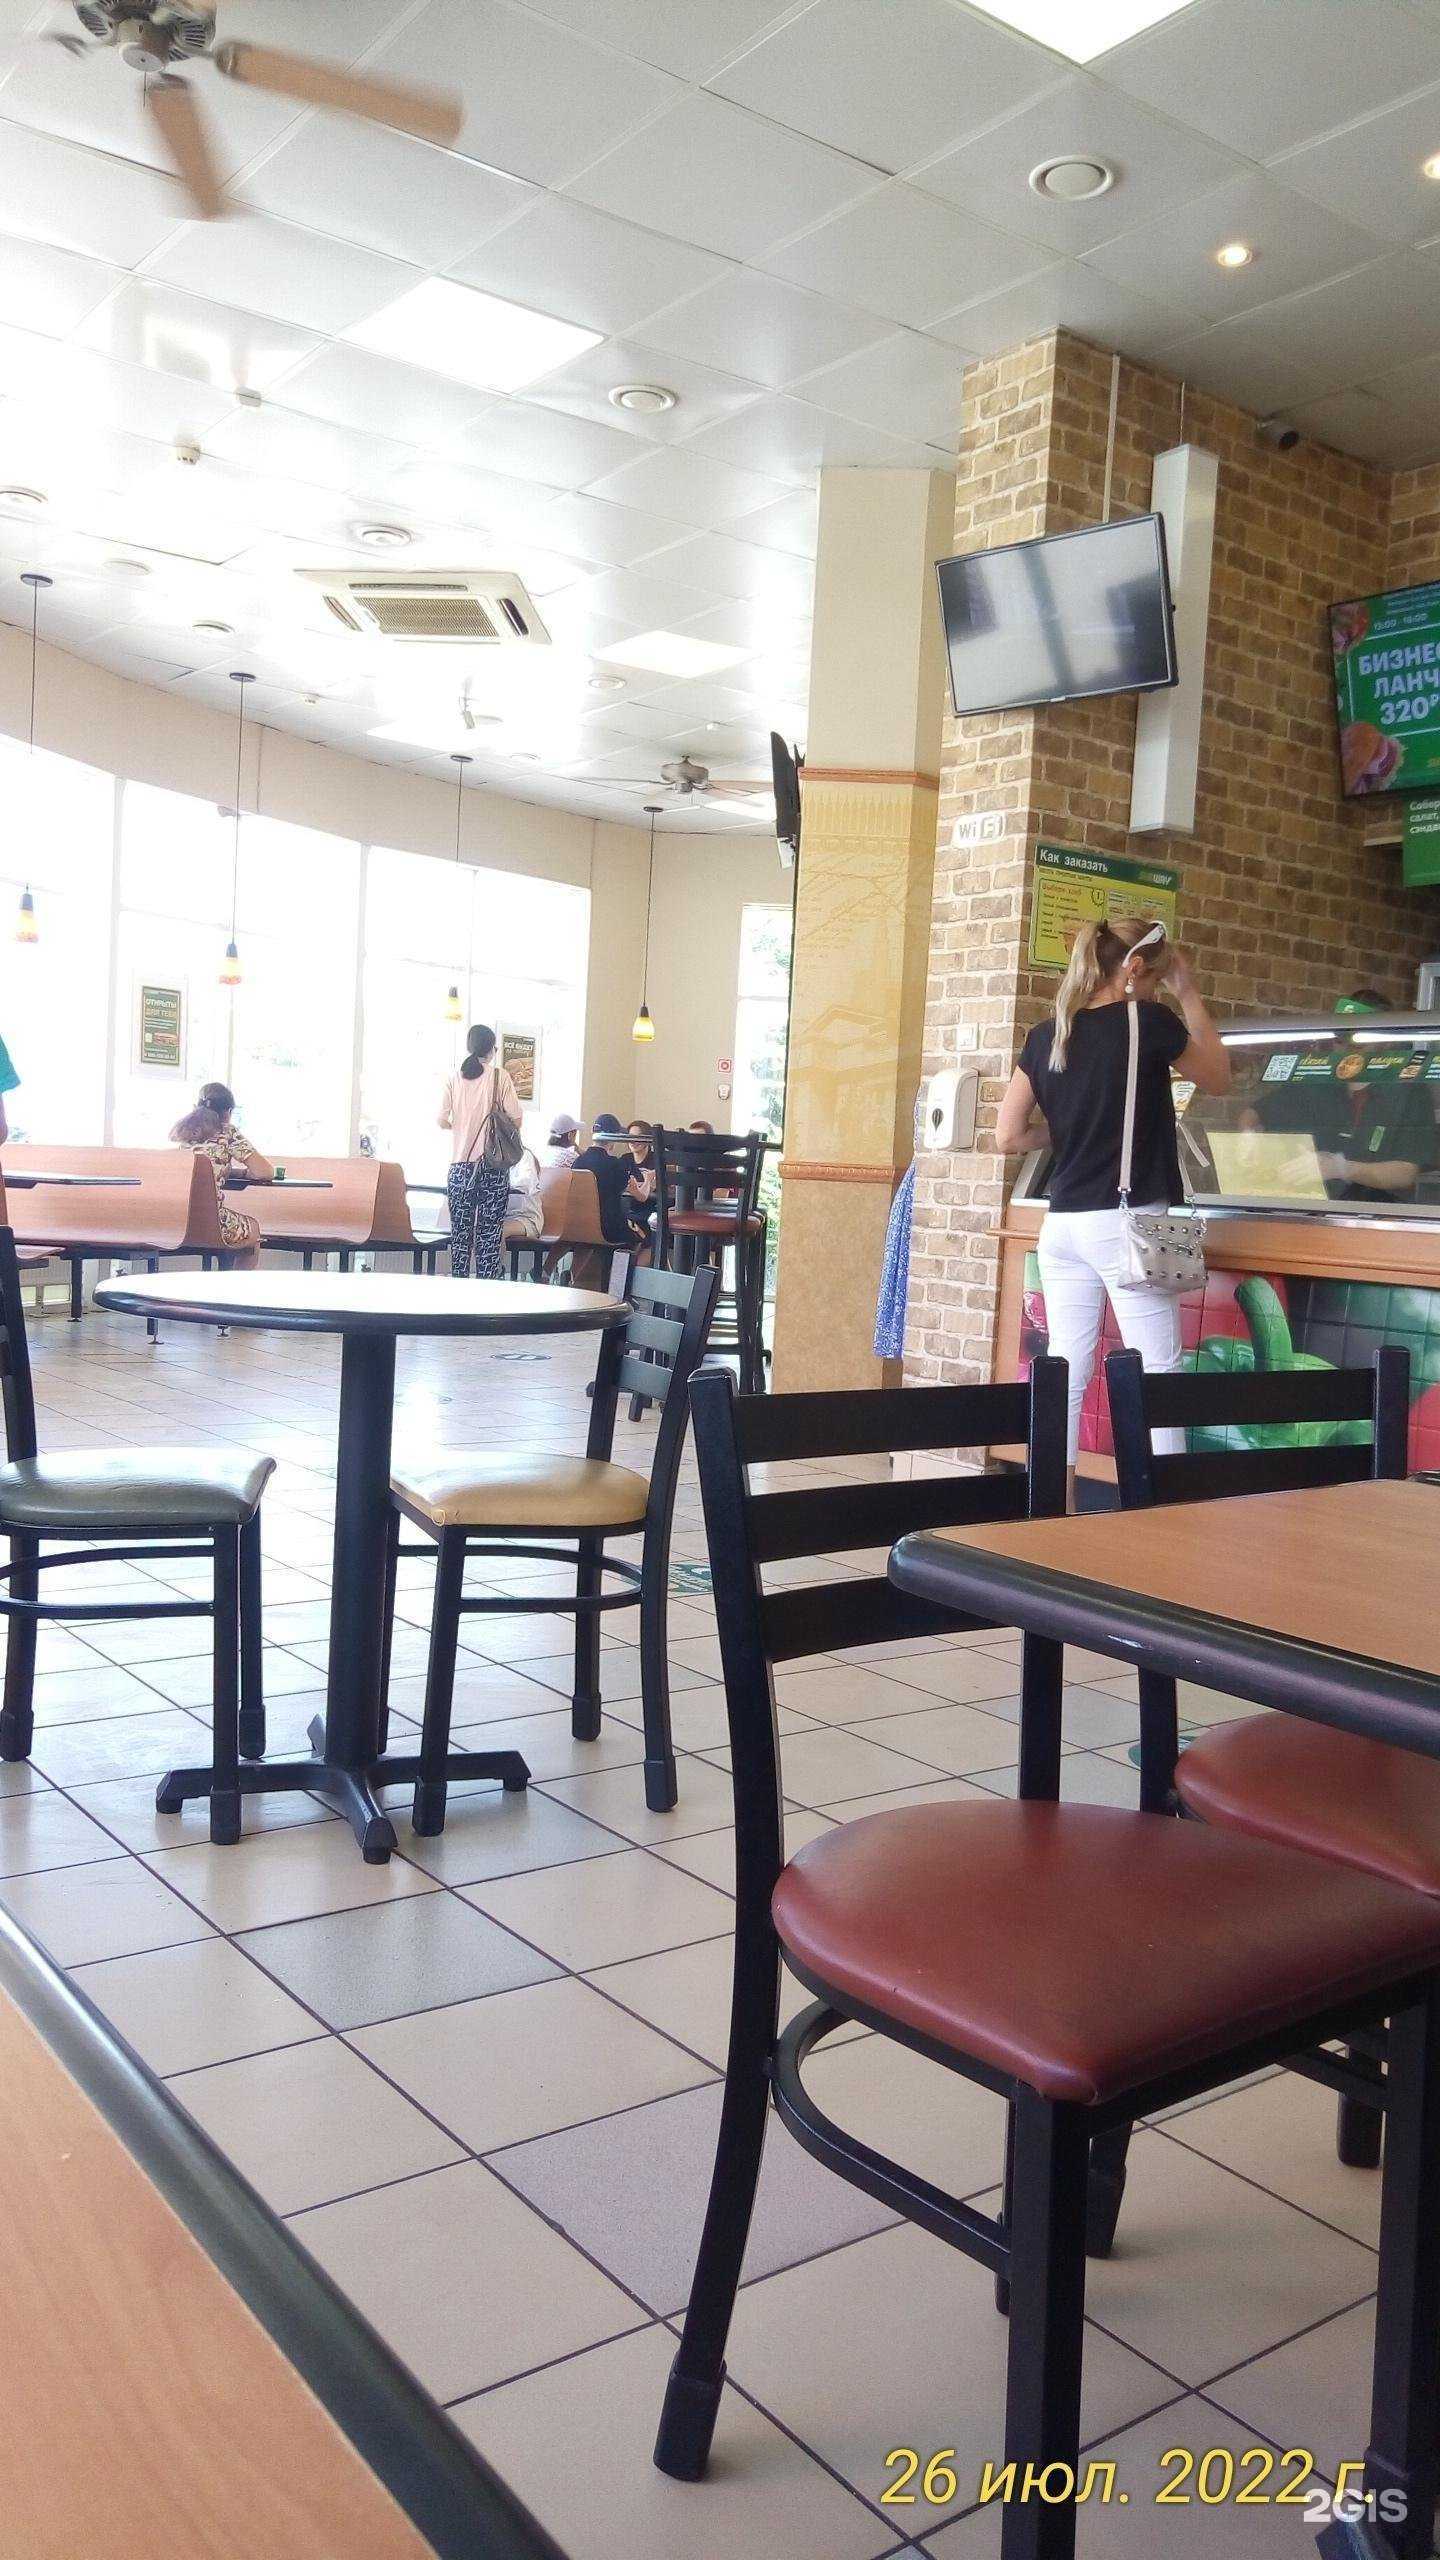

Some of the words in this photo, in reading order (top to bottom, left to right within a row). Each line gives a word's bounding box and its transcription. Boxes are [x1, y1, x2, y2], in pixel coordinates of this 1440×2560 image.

[1374, 668, 1440, 699] ЛАНЧ
[1040, 848, 1060, 864] Как
[1064, 855, 1108, 873] заказать
